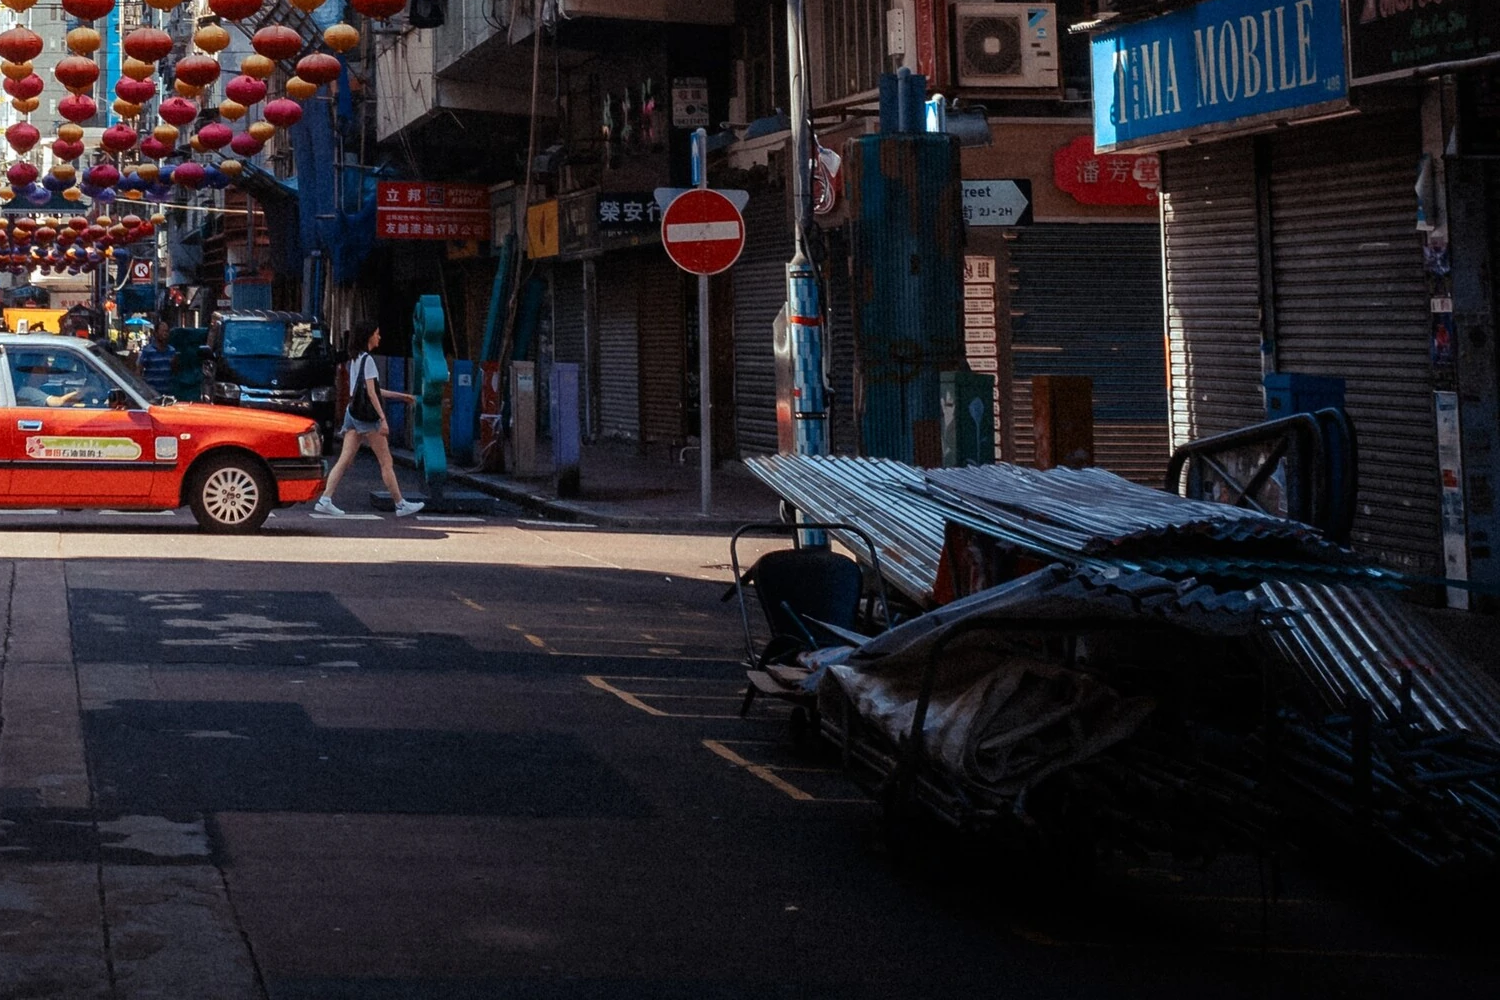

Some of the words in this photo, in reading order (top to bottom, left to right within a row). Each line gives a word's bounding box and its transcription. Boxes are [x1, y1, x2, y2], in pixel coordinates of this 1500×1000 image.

[1076, 158, 1160, 184] 潘芳堂
[386, 187, 422, 203] 立邦
[962, 186, 992, 198] reet
